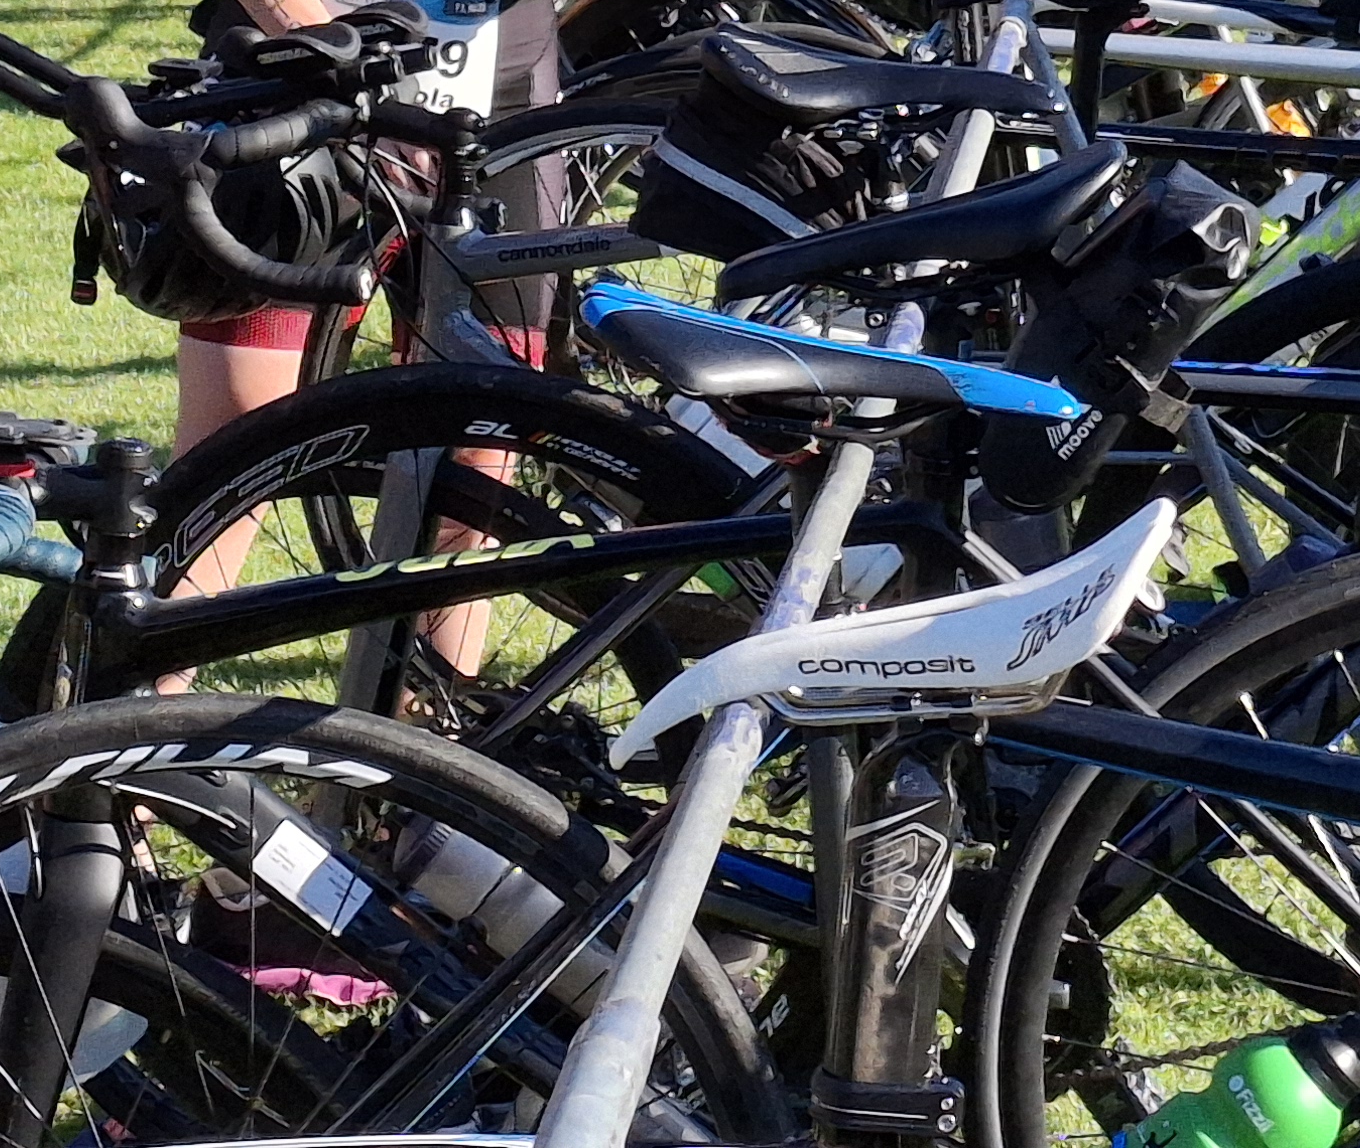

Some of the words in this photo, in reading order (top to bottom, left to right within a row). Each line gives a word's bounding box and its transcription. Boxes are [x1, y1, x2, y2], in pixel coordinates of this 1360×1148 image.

[497, 236, 611, 263] cannondale
[1056, 408, 1104, 462] moove
[797, 654, 977, 681] composit
